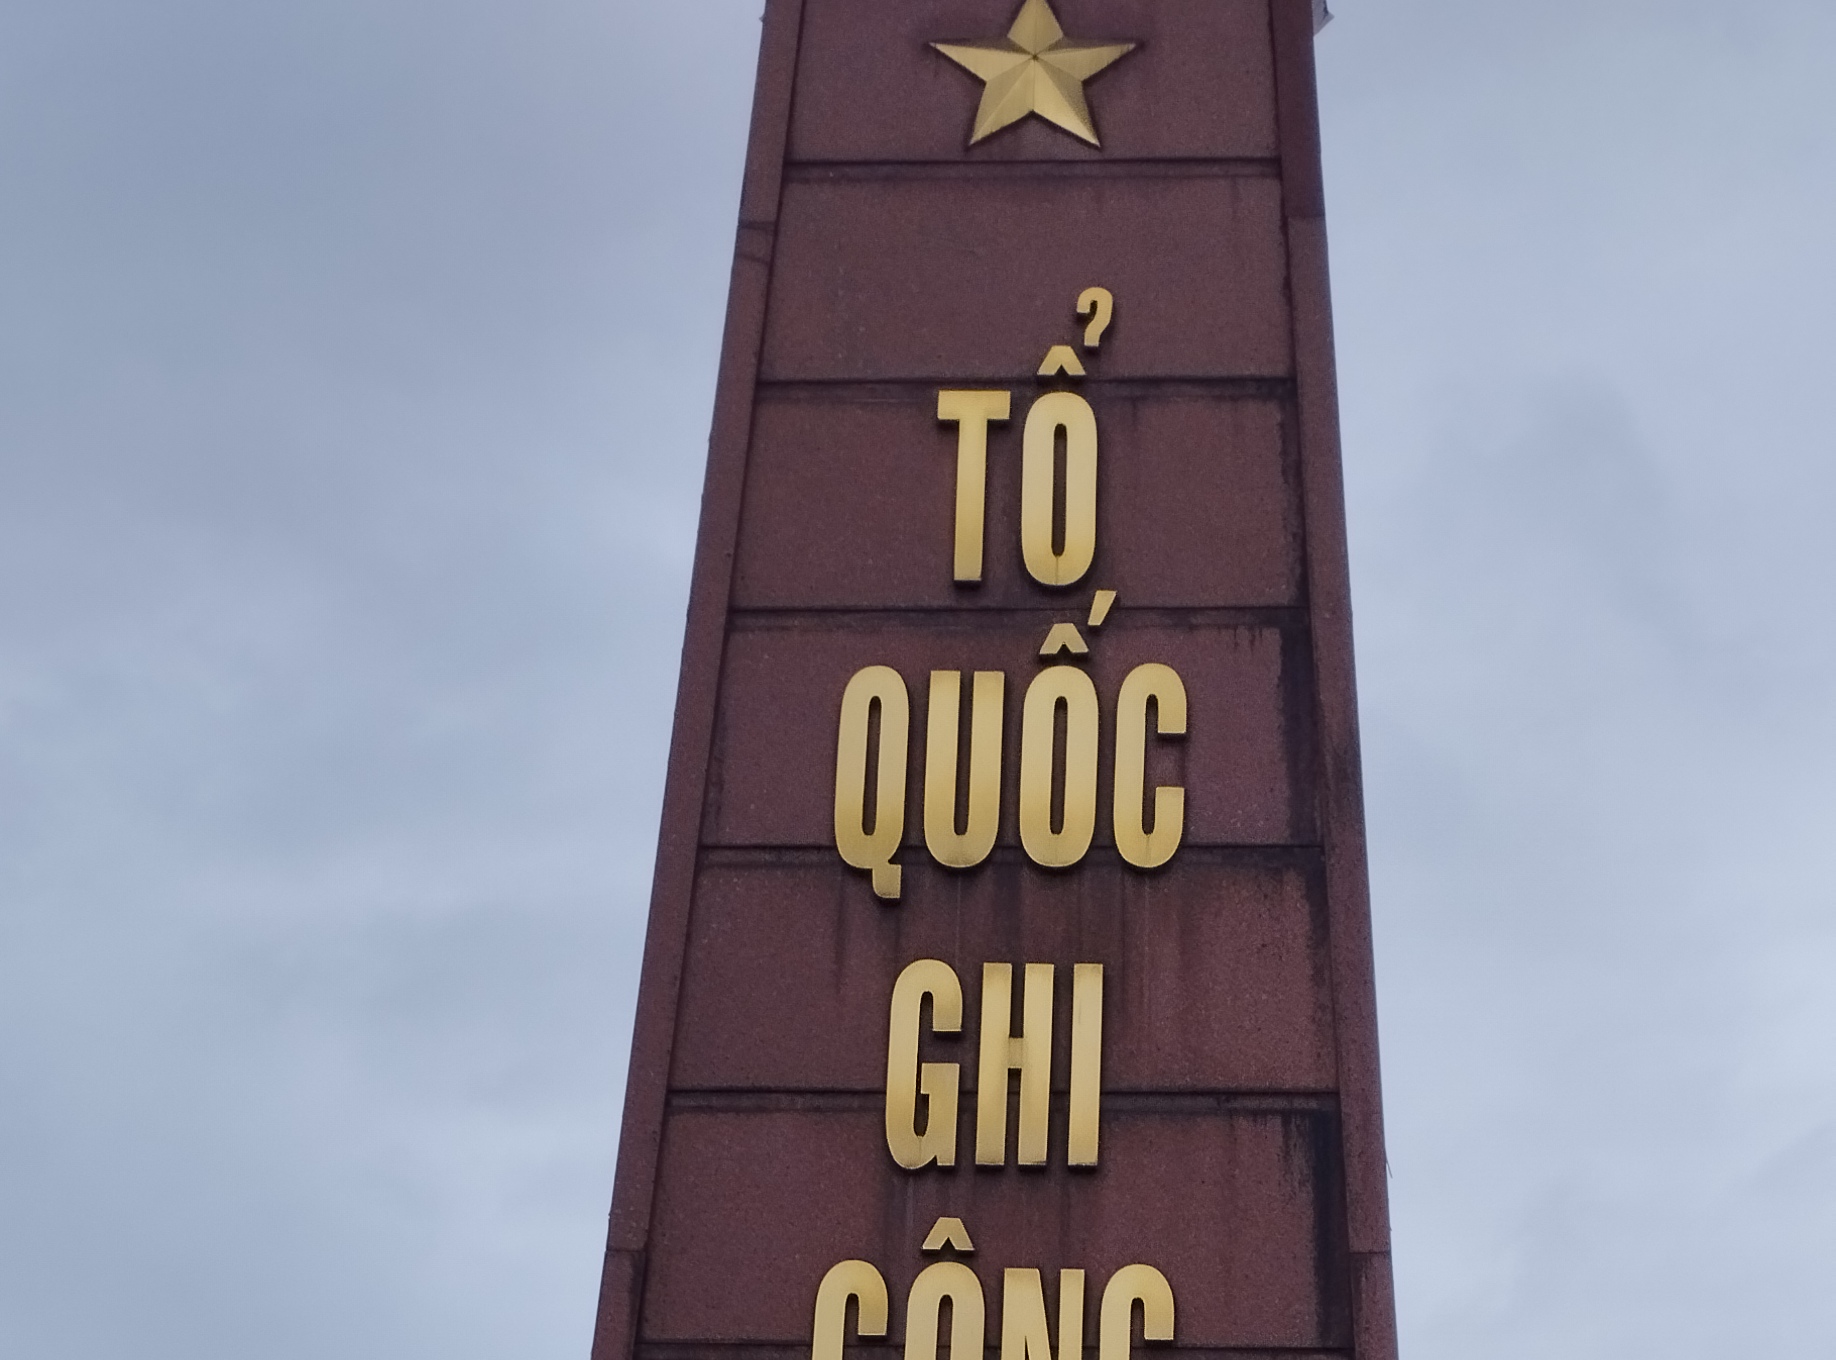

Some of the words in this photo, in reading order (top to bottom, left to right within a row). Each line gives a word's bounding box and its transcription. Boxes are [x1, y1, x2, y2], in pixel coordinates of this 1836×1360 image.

[936, 285, 1114, 586] TỔ
[832, 589, 1189, 899] QUỐC
[884, 957, 1104, 1168] GHI
